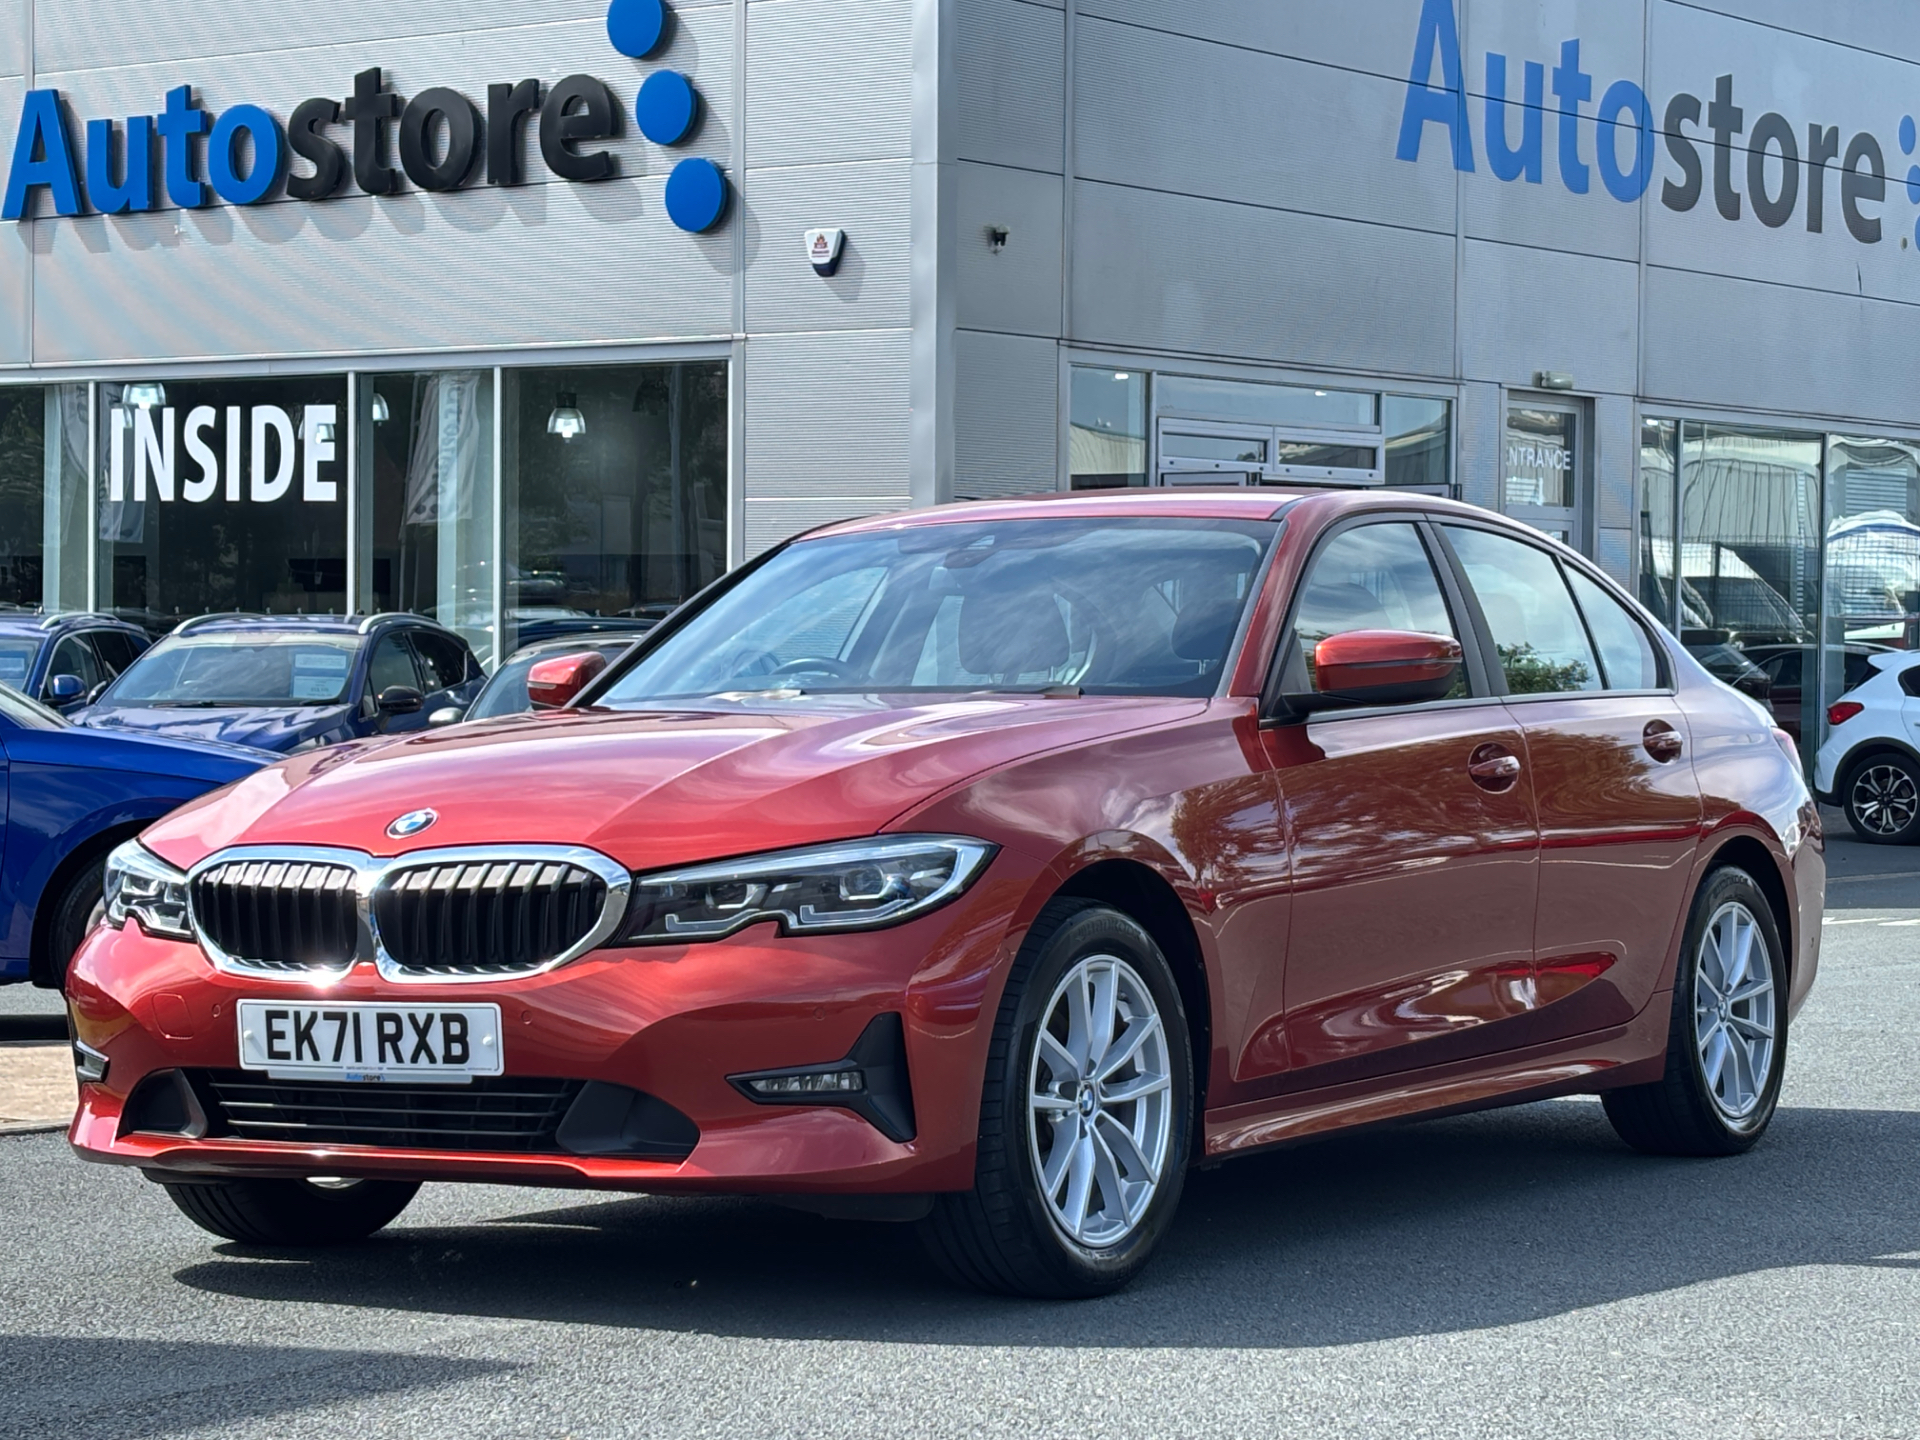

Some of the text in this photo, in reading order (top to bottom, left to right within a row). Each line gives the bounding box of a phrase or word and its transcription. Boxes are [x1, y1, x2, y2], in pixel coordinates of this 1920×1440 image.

[1, 67, 619, 220] Autostore
[1395, 0, 1886, 244] Autostore
[110, 404, 337, 502] INSIDE
[1506, 446, 1571, 470] NTRANCE
[265, 1010, 470, 1064] EK71 RXB
